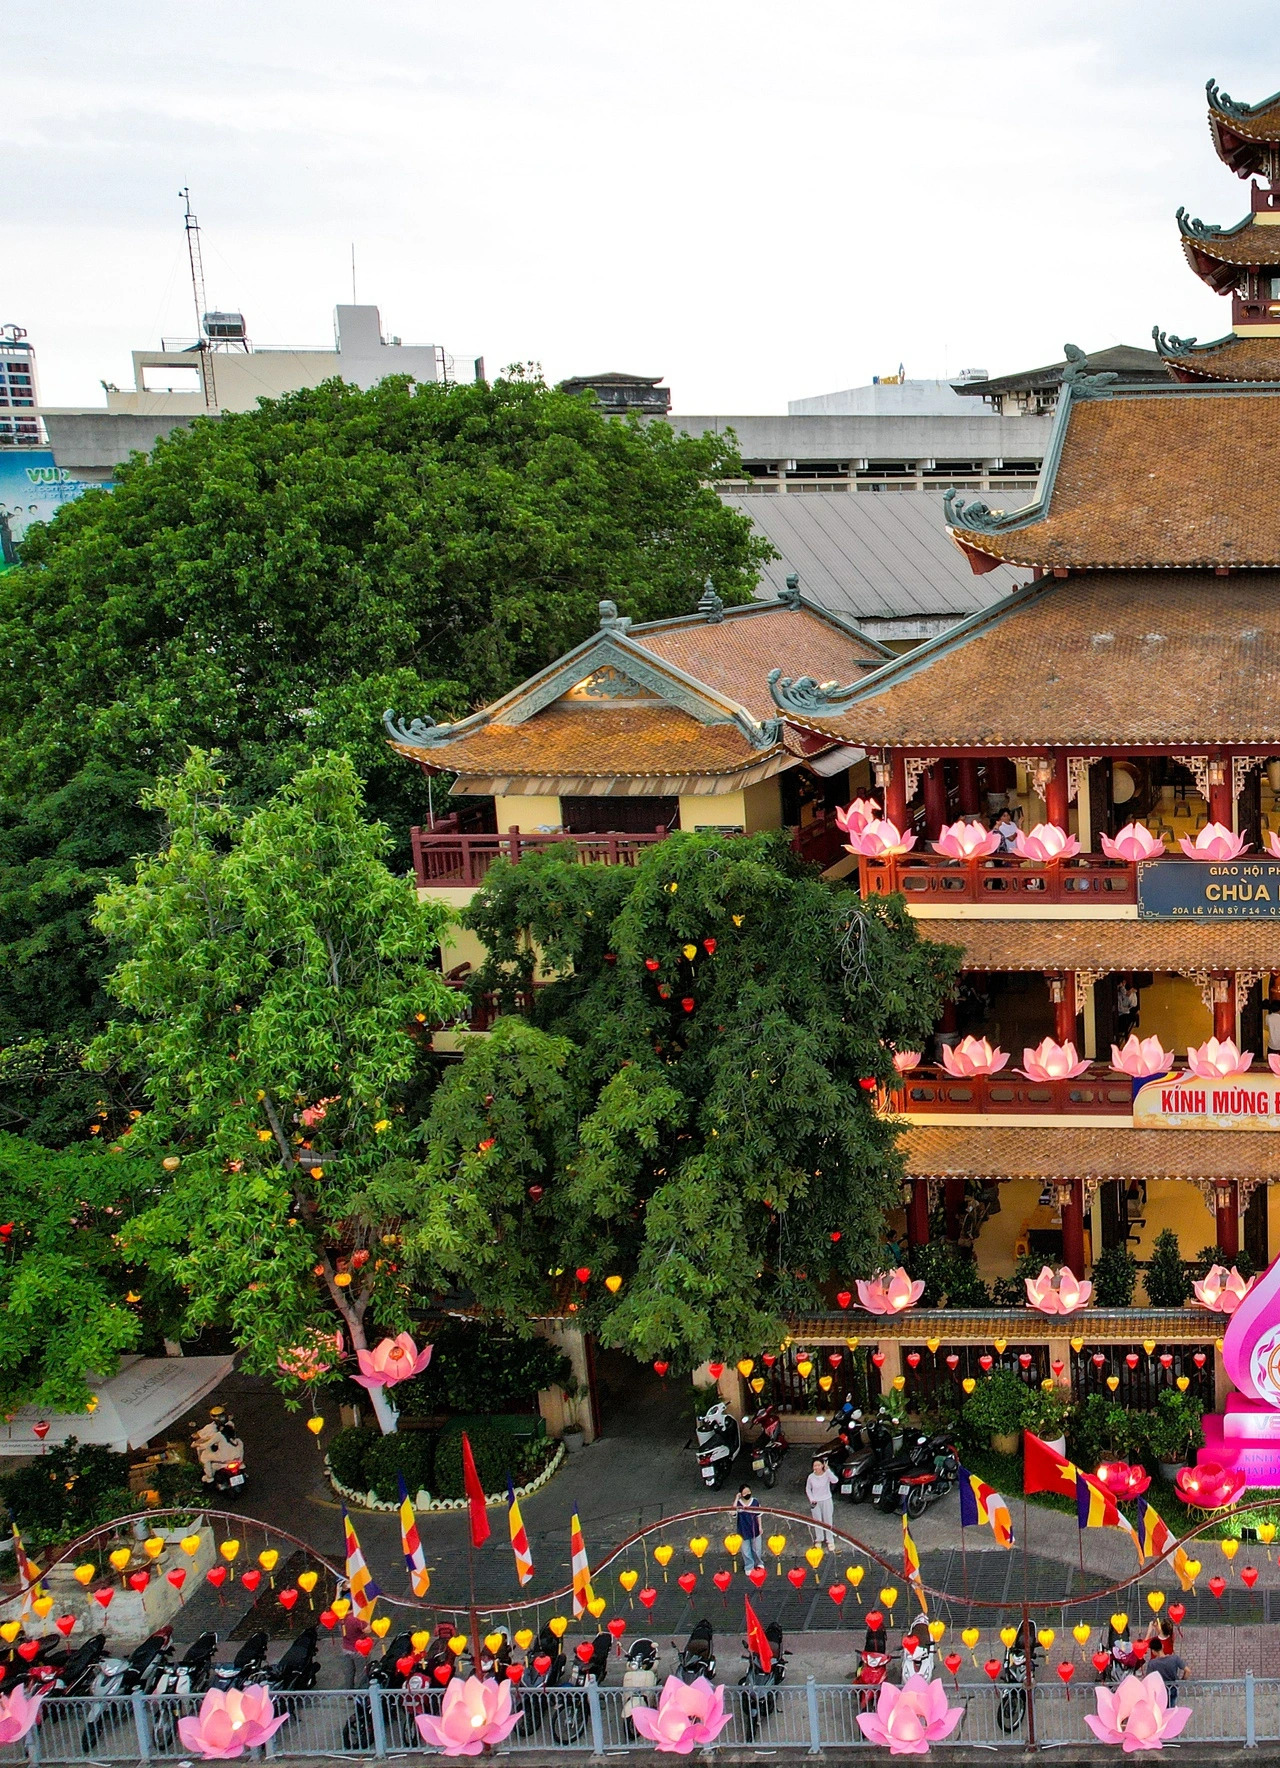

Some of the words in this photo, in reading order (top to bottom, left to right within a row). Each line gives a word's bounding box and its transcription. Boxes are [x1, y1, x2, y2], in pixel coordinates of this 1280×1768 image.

[1209, 866, 1239, 876] GIAO
[1243, 864, 1264, 878] HỘI
[1204, 878, 1271, 901] CHÙA
[1172, 906, 1190, 915] 20A
[1161, 1084, 1207, 1114] KÍNH
[1212, 1085, 1269, 1115] MỪNG
